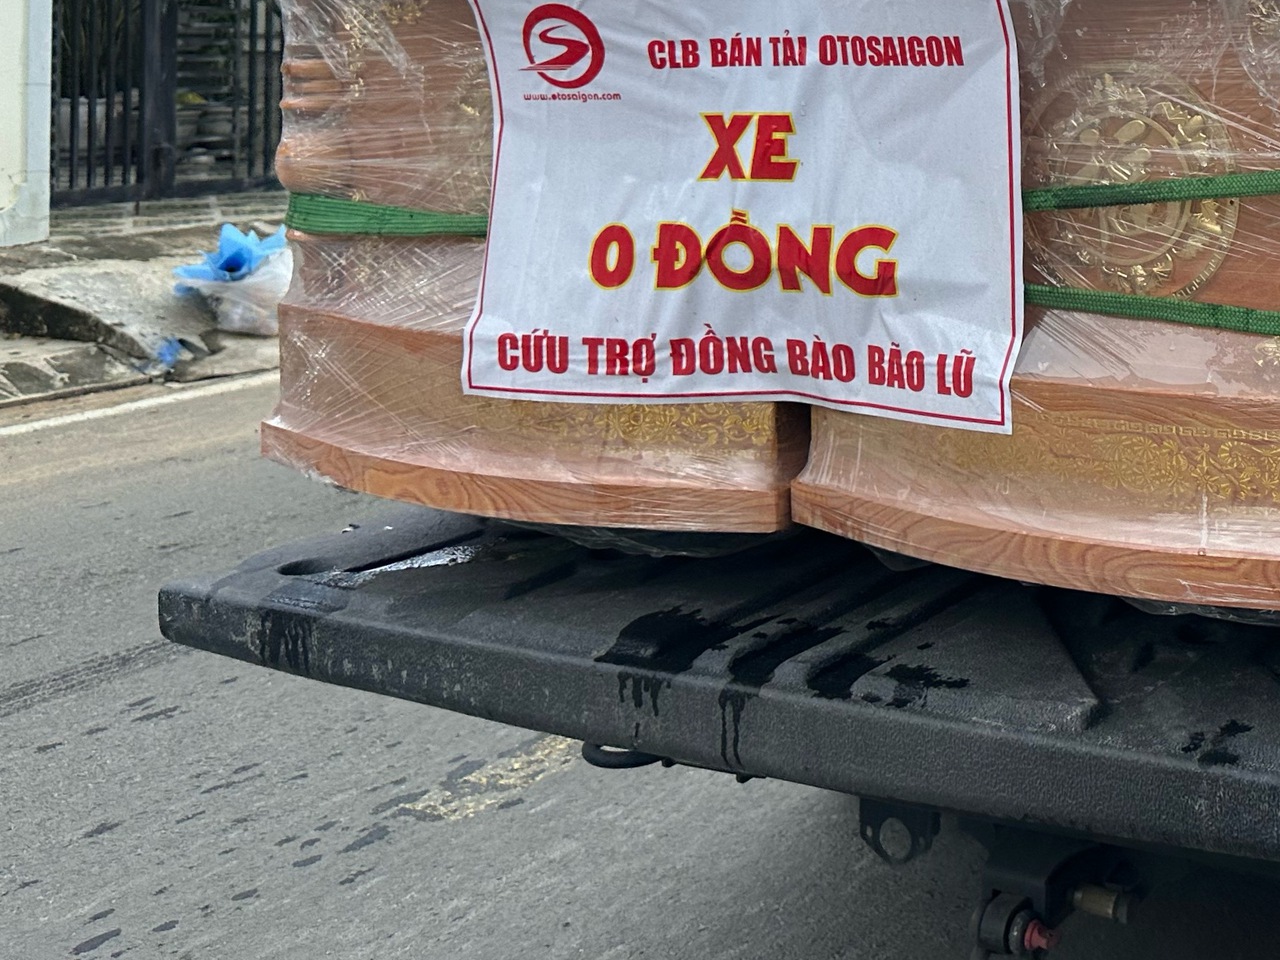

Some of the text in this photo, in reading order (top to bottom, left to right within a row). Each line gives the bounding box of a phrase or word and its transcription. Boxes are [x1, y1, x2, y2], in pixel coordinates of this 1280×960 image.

[648, 29, 965, 69] CLB BÁN TẢI OTOSAIGON
[523, 91, 622, 102] www.otosaigon.com
[700, 111, 800, 181] XE
[650, 208, 899, 298] ĐỒNG
[498, 323, 977, 398] CỨU TRỢ ĐỒNG BÀO BÃO LŨ
